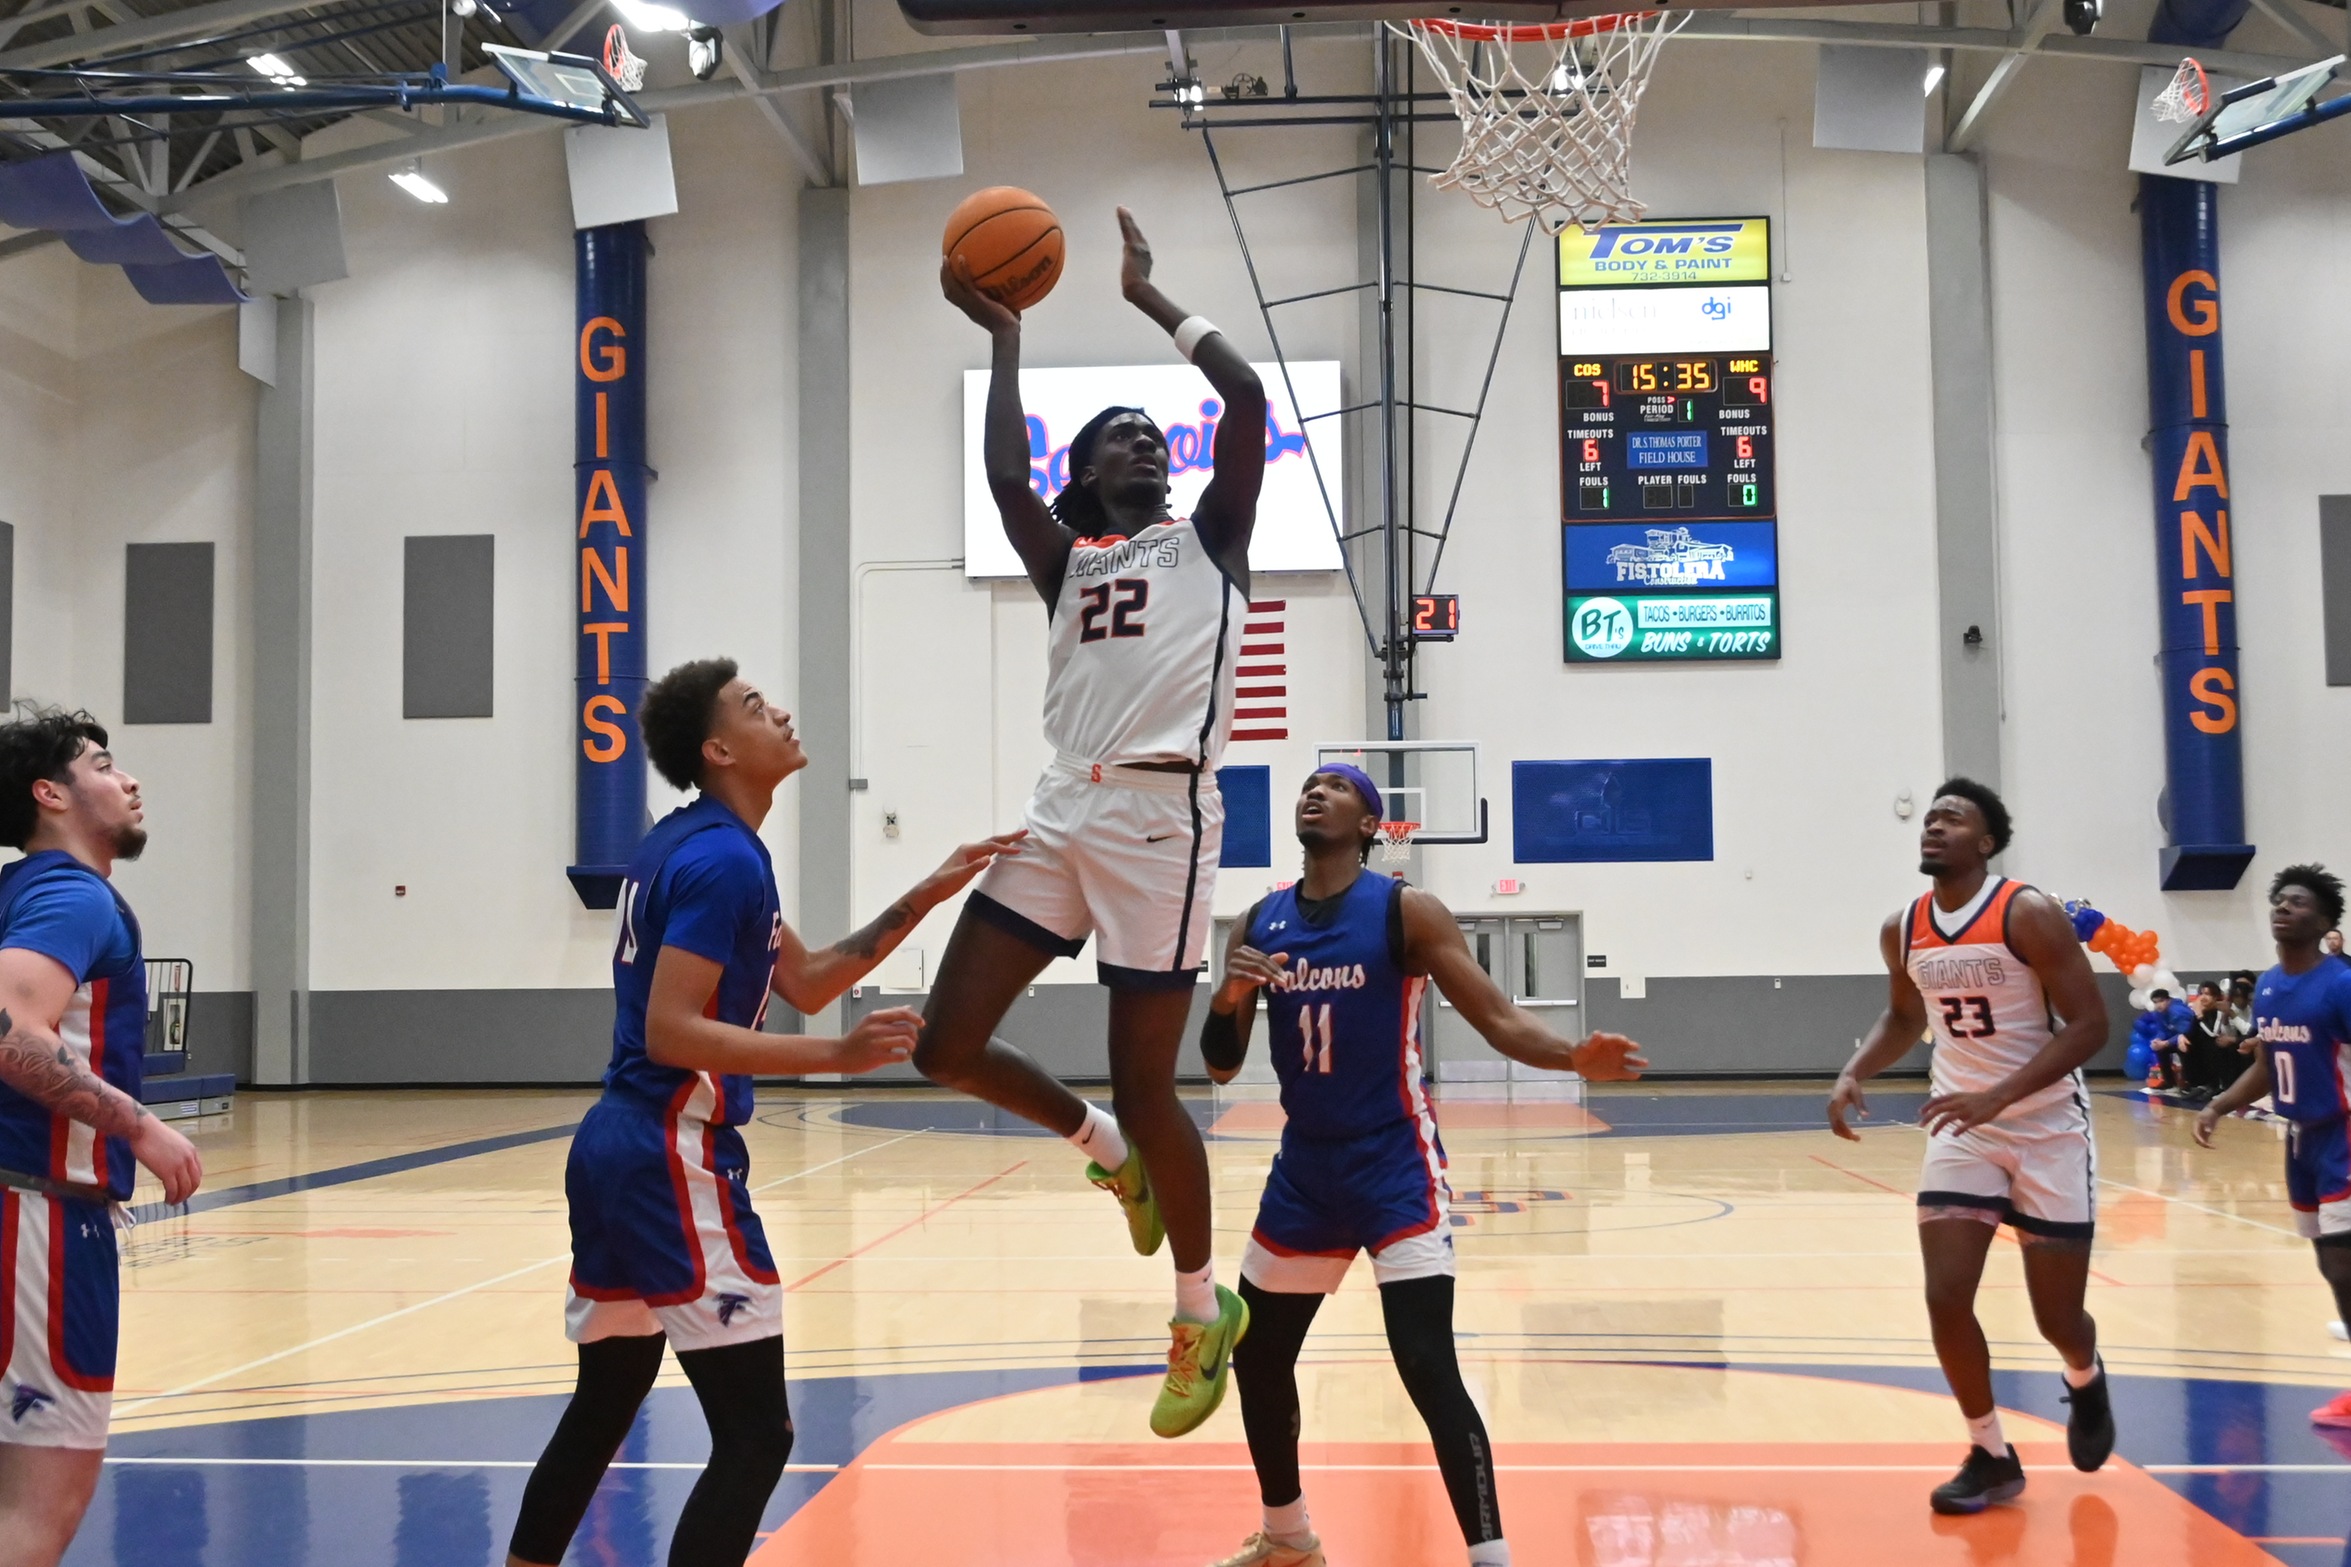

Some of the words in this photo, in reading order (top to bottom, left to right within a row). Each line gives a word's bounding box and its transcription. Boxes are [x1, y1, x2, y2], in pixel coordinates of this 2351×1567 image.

[1583, 223, 1745, 259] TOM'S
[1594, 260, 1648, 271] BODY
[1655, 260, 1668, 270] &
[1675, 258, 1732, 269] PAINT
[1632, 271, 1697, 282] 732-3914
[1701, 296, 1732, 321] dgi
[1573, 363, 1602, 377] COS
[1632, 362, 1710, 390] 15:35
[1729, 360, 1759, 373] WHC
[1592, 380, 1610, 407] 7
[1647, 396, 1666, 404] POSS
[1748, 377, 1767, 403] 9
[1583, 412, 1614, 422] BONUS
[1640, 404, 1674, 414] PERIOD
[1686, 400, 1693, 421] 1
[1718, 409, 1750, 419] BONUS
[1567, 429, 1614, 439] TIMEOUTS
[1720, 425, 1767, 436] TIMEOUTS
[1583, 439, 1599, 461] 6
[1649, 436, 1675, 448] THOMAS
[1677, 436, 1702, 448] PORTER
[1737, 436, 1752, 458] 6
[1580, 462, 1602, 472] LEFT
[1639, 452, 1665, 464] FIELD
[1667, 451, 1696, 463] HOUSE
[1734, 458, 1756, 468] LEFT
[1580, 476, 1608, 486] FOULS
[1638, 475, 1673, 485] PLAYER
[1678, 474, 1707, 484] FOULS
[1727, 473, 1757, 483] FOULS
[1602, 487, 1609, 508] 1
[1742, 484, 1757, 506] 0
[2166, 270, 2237, 735] GIANTS
[578, 316, 632, 763] GIANTS
[1069, 537, 1180, 579] IANTS
[1616, 560, 1726, 582] FISTOLERA
[1079, 578, 1149, 644] 22
[1416, 599, 1456, 630] 21
[1644, 606, 1670, 622] TACOS
[1678, 605, 1717, 622] BURGERS
[1726, 604, 1766, 621] BURRITOS
[1640, 631, 1692, 653] BUNS
[1708, 631, 1771, 653] TORTS
[1091, 764, 1102, 783] S
[1917, 958, 2005, 990] GIANTS
[1938, 996, 1996, 1038] 23
[1298, 1003, 1332, 1074] 11
[2256, 1016, 2312, 1044] Falcons
[2274, 1052, 2296, 1104] 0
